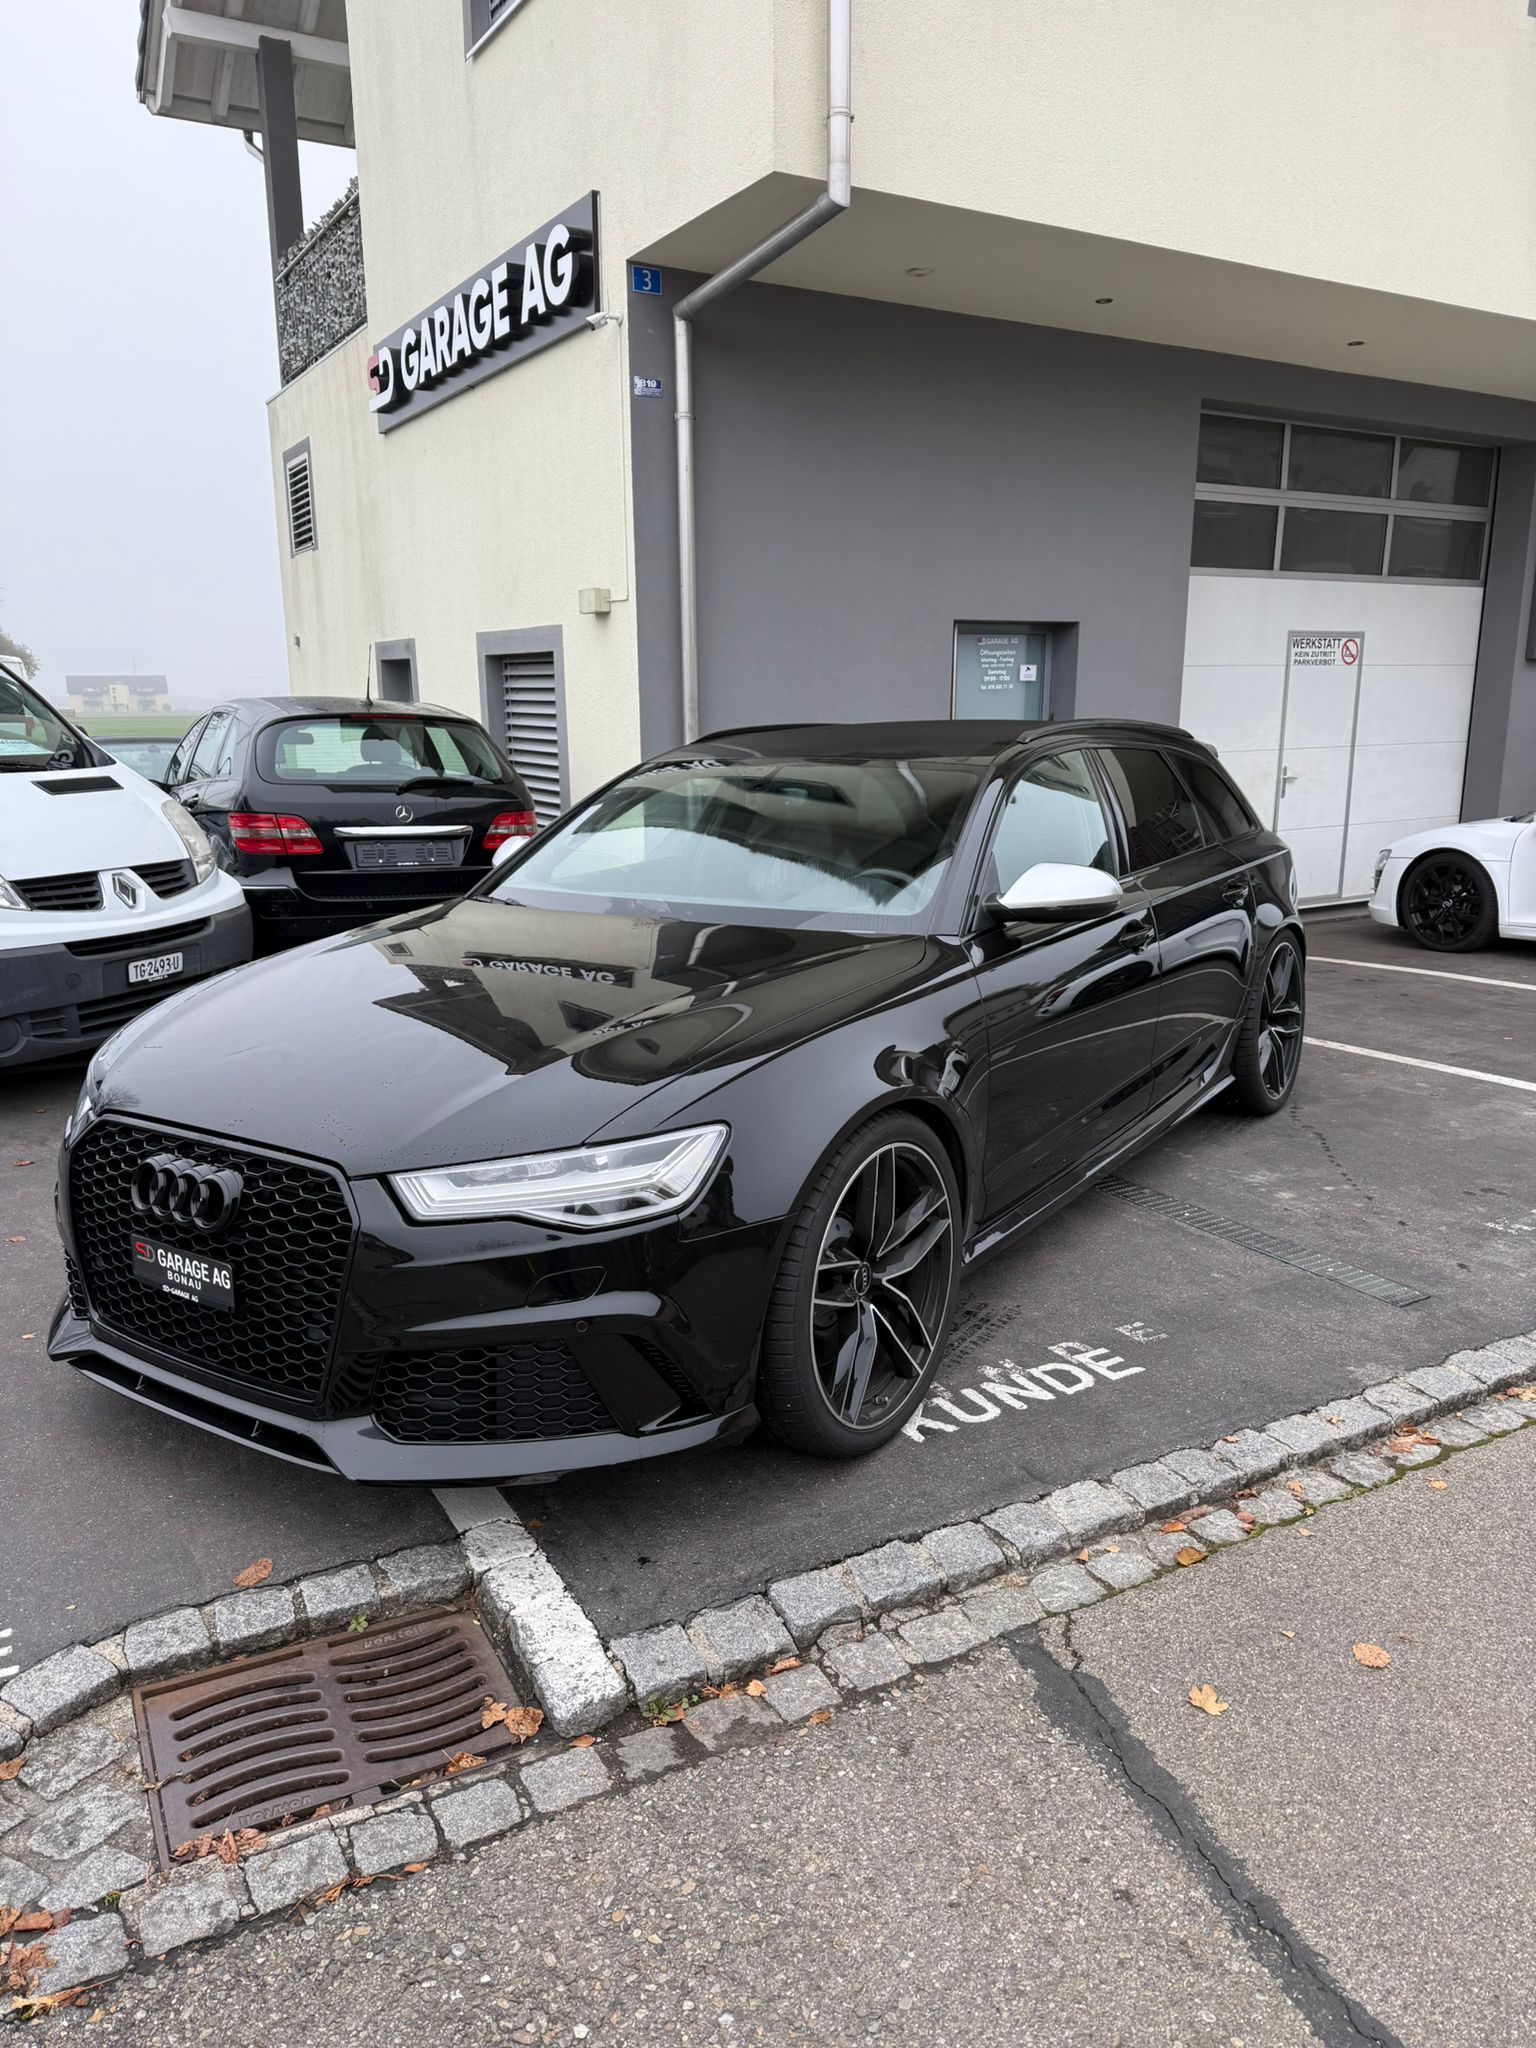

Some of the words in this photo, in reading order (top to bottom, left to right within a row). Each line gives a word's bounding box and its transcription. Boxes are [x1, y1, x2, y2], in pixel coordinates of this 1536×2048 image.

[642, 269, 652, 290] 3
[400, 262, 510, 390] GARAGE
[520, 224, 573, 325] AG
[1292, 638, 1342, 649] WERKSTATT
[134, 1241, 156, 1263] SD
[157, 1248, 210, 1282] GARAGE
[213, 1267, 231, 1289] AG
[167, 1270, 202, 1290] BONAU
